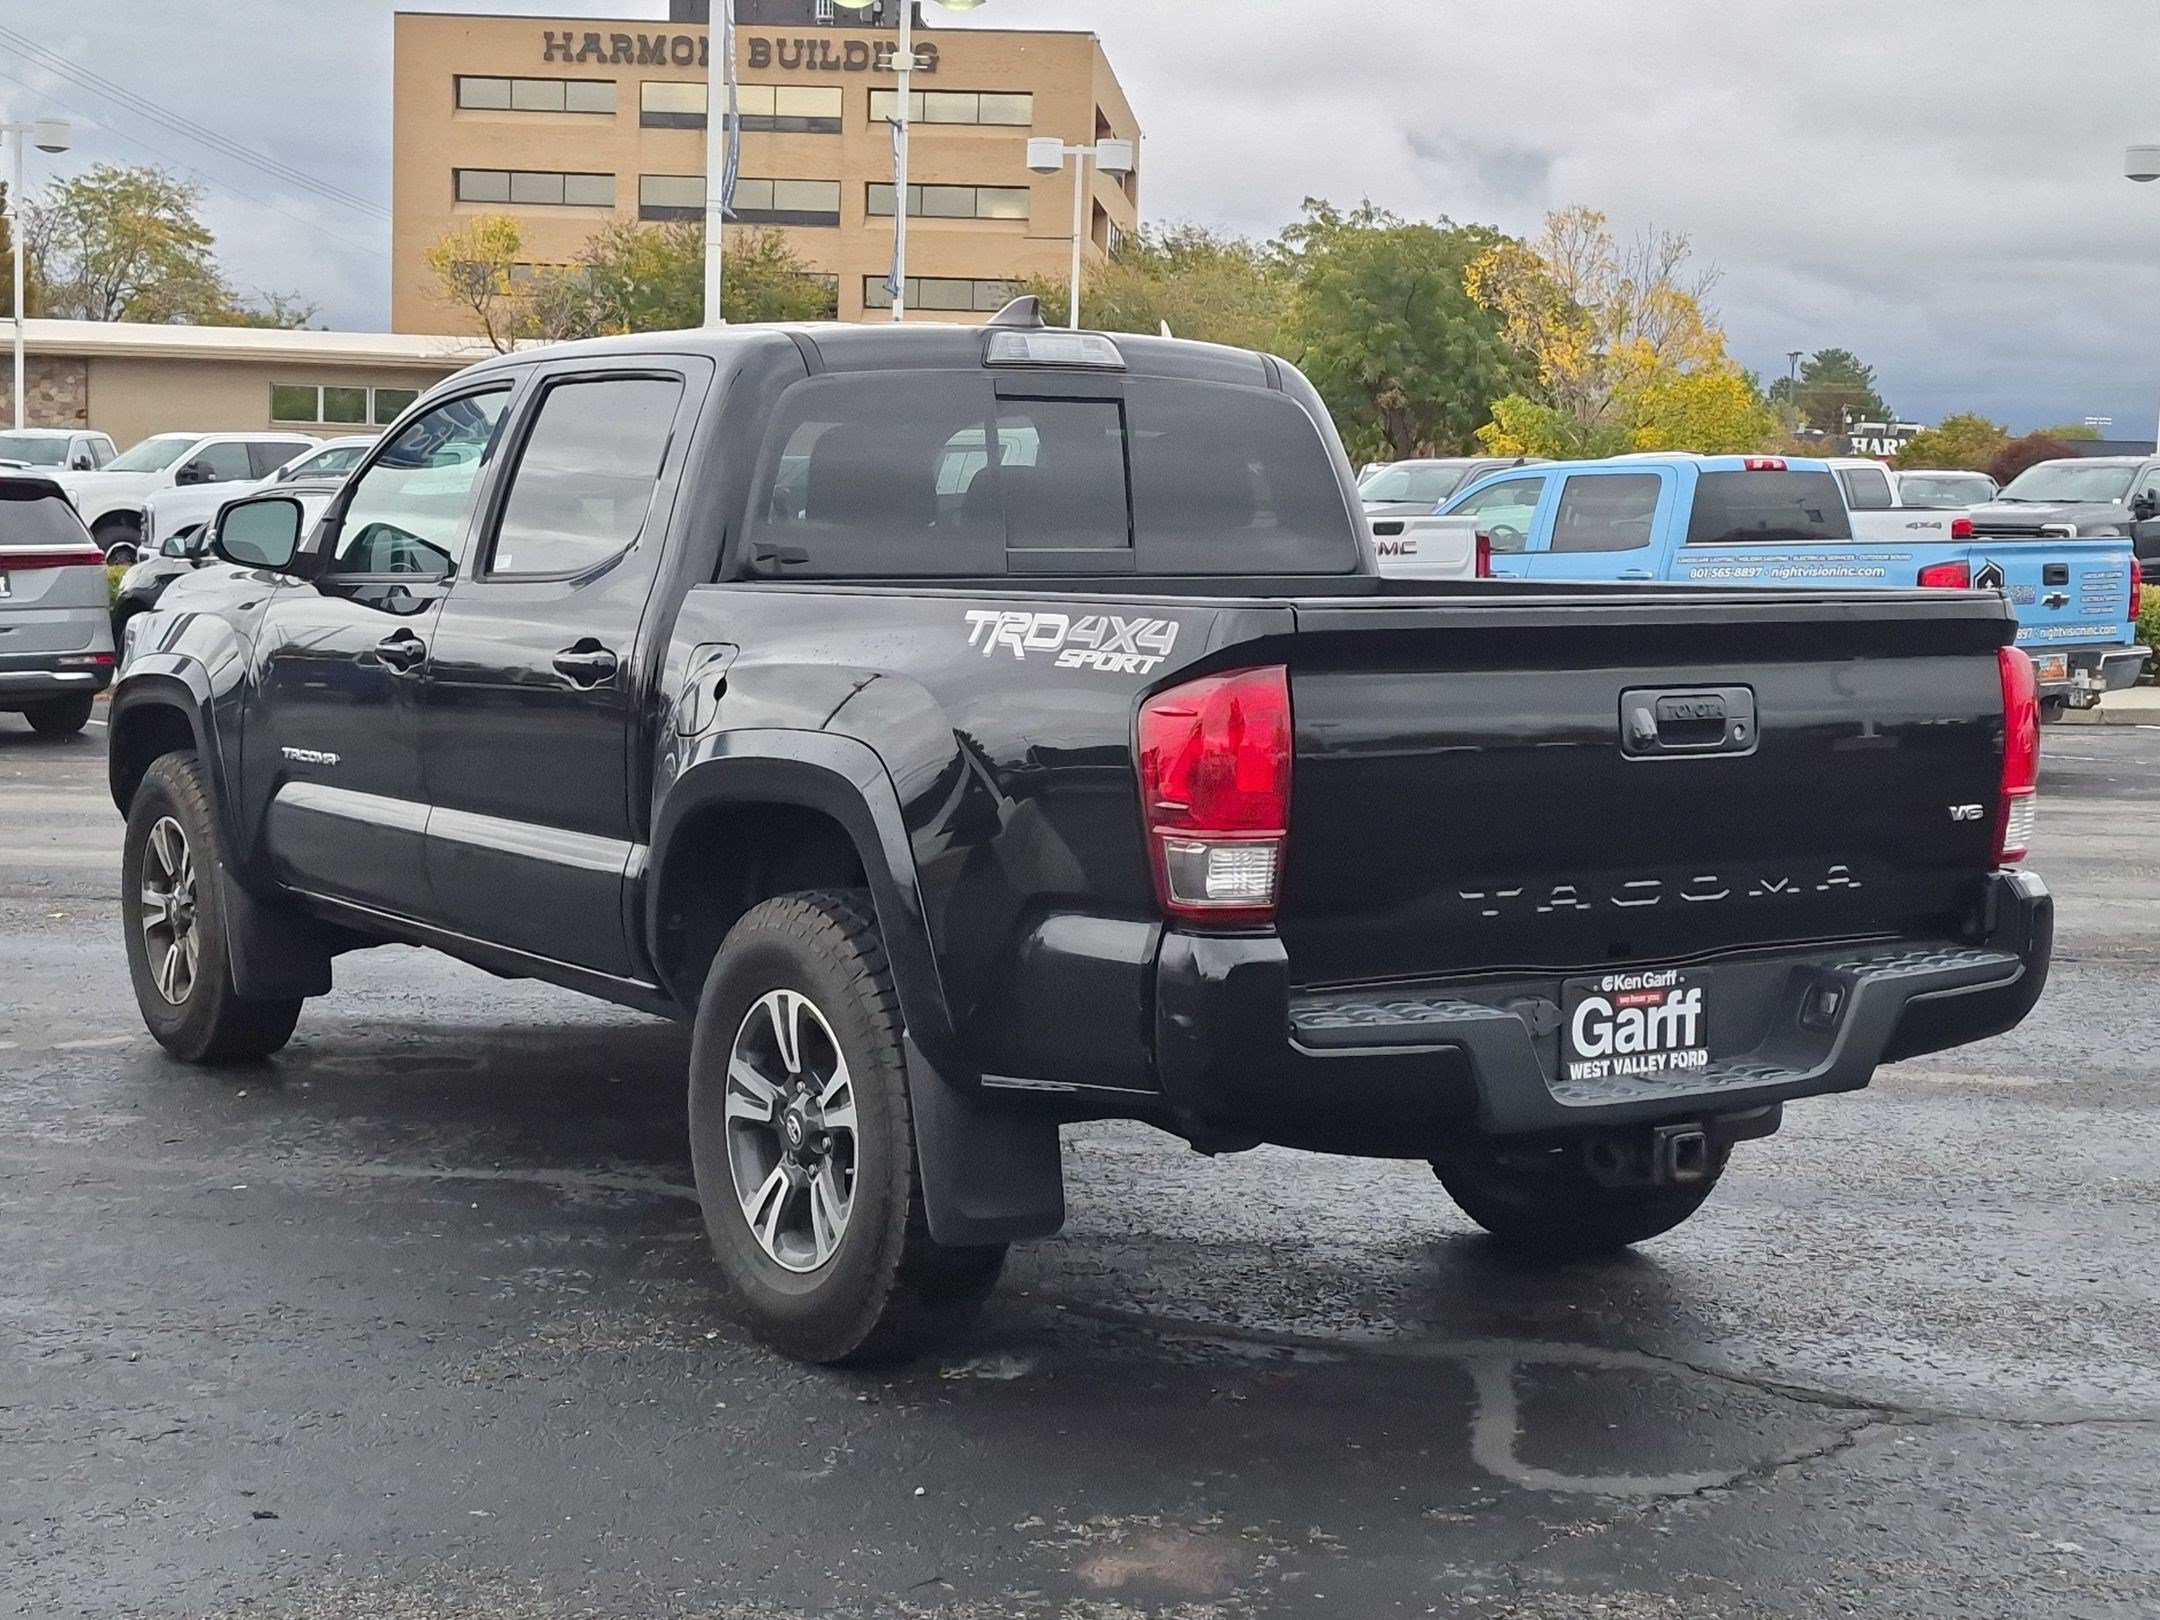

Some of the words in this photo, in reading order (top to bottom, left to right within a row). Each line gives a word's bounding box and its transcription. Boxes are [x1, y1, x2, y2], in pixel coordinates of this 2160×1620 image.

[1771, 564, 1886, 580] nightvisioninc.com
[964, 610, 1069, 660] TRD
[1054, 649, 1165, 675] SPORT
[1949, 804, 1984, 821] V6
[1613, 974, 1642, 991] Ken
[1642, 969, 1678, 988] Garff
[1572, 987, 1702, 1058] Garff
[1570, 1060, 1610, 1080] WEST
[1613, 1053, 1668, 1075] VALLEY
[1670, 1050, 1709, 1069] FORD
